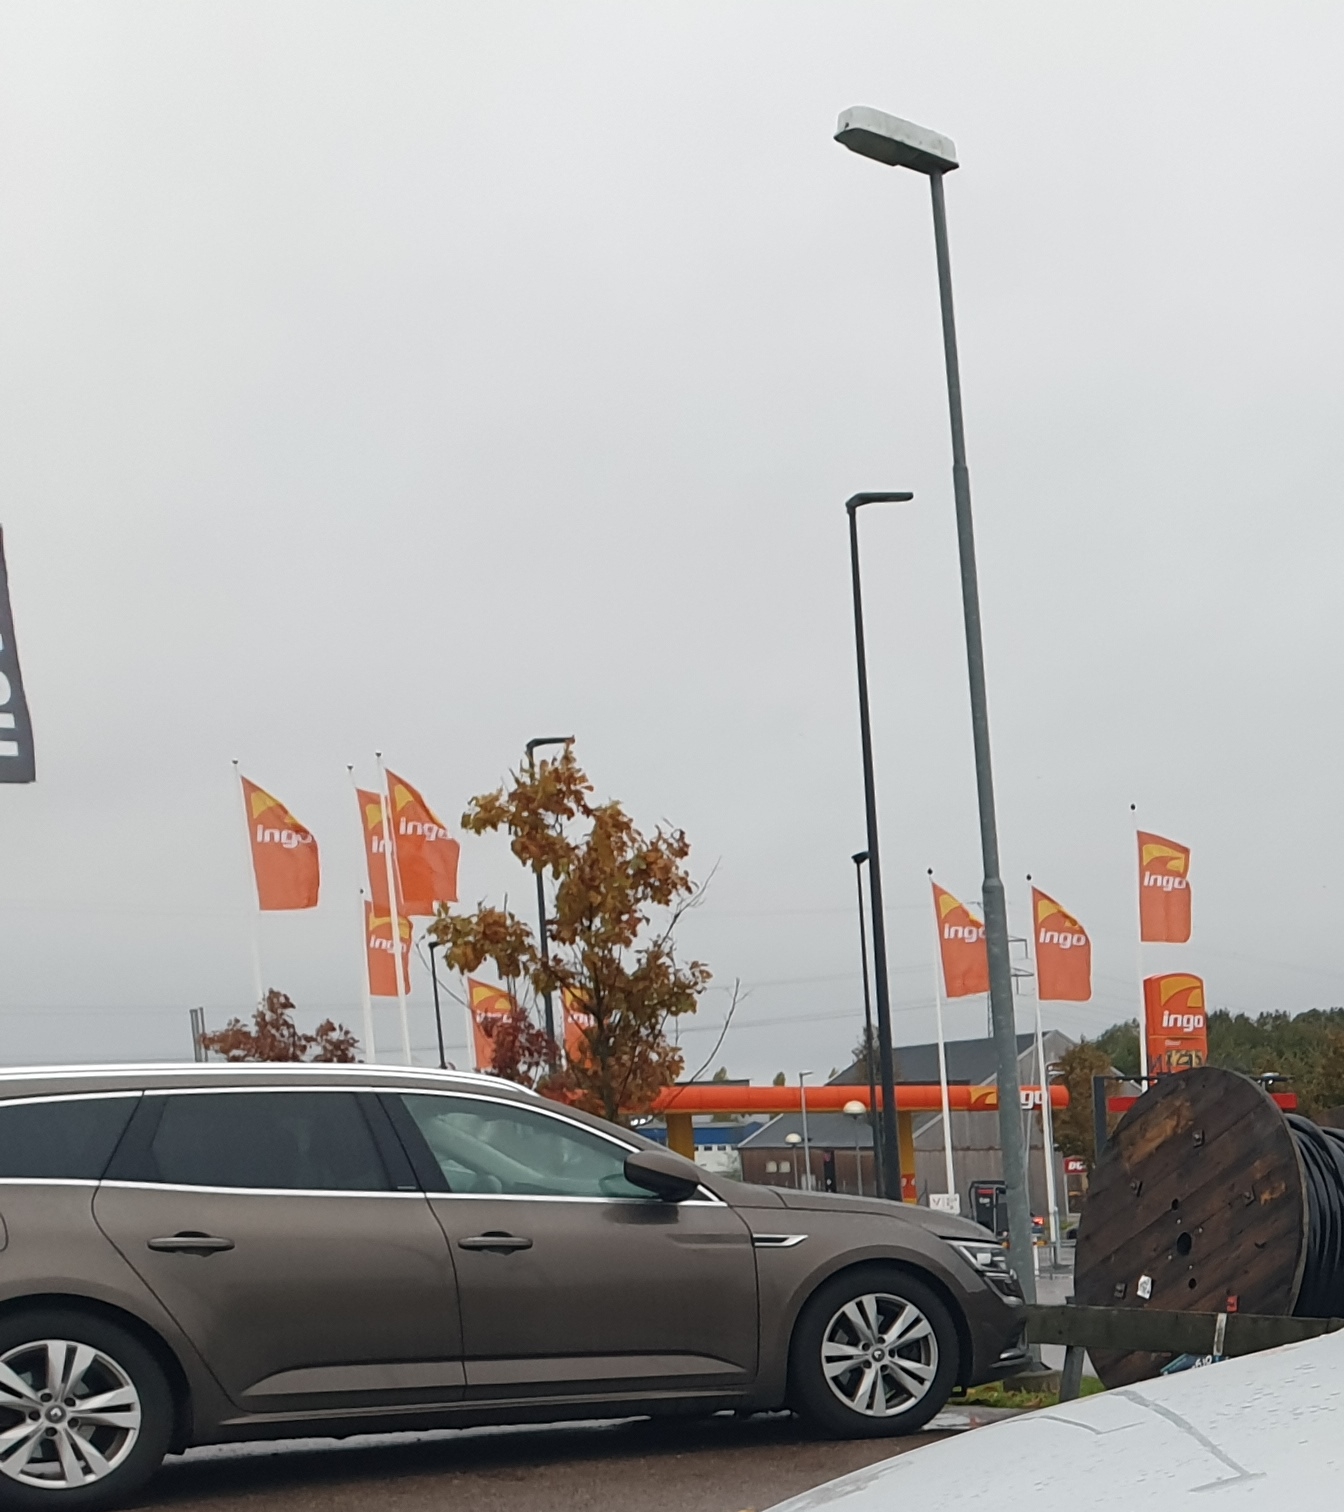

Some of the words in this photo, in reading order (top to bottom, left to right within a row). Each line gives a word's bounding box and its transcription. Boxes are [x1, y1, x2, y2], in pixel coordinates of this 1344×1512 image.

[1143, 871, 1187, 891] ingo
[1039, 927, 1086, 949] ingo
[1162, 1010, 1204, 1032] ingo
[1020, 1090, 1045, 1110] go
